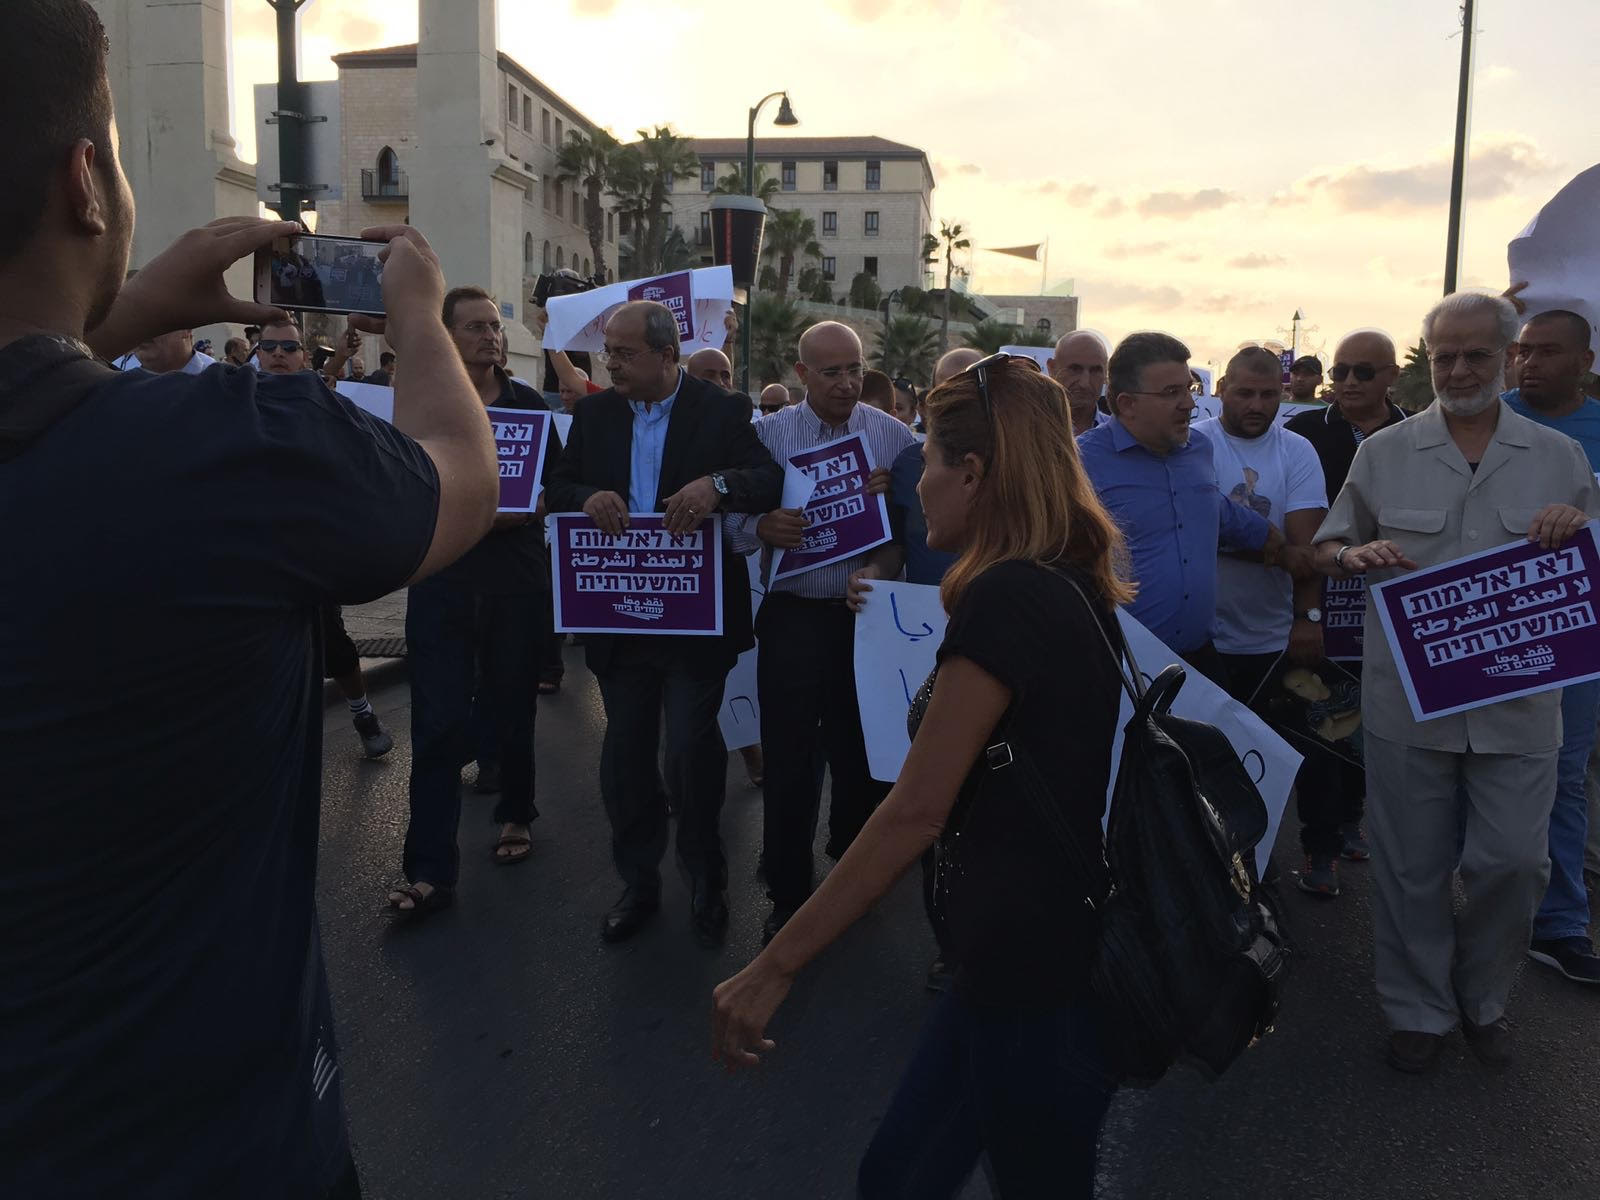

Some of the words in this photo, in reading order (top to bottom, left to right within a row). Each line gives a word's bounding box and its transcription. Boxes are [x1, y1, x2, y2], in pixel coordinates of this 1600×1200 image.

[503, 423, 529, 439] לא
[827, 455, 851, 477] לא
[575, 530, 662, 548] לאלימות
[669, 532, 698, 549] לא
[571, 551, 636, 569] الشرطة
[640, 552, 687, 569] لعنف
[691, 554, 704, 569] لا
[1535, 550, 1575, 577] לא
[579, 573, 697, 592] המשטרתית
[1408, 563, 1527, 615] לאלימות
[1572, 576, 1592, 596] لا
[1506, 582, 1568, 613] لعنف
[1412, 601, 1500, 641] الشرطة
[1429, 604, 1591, 663] המשטרתית
